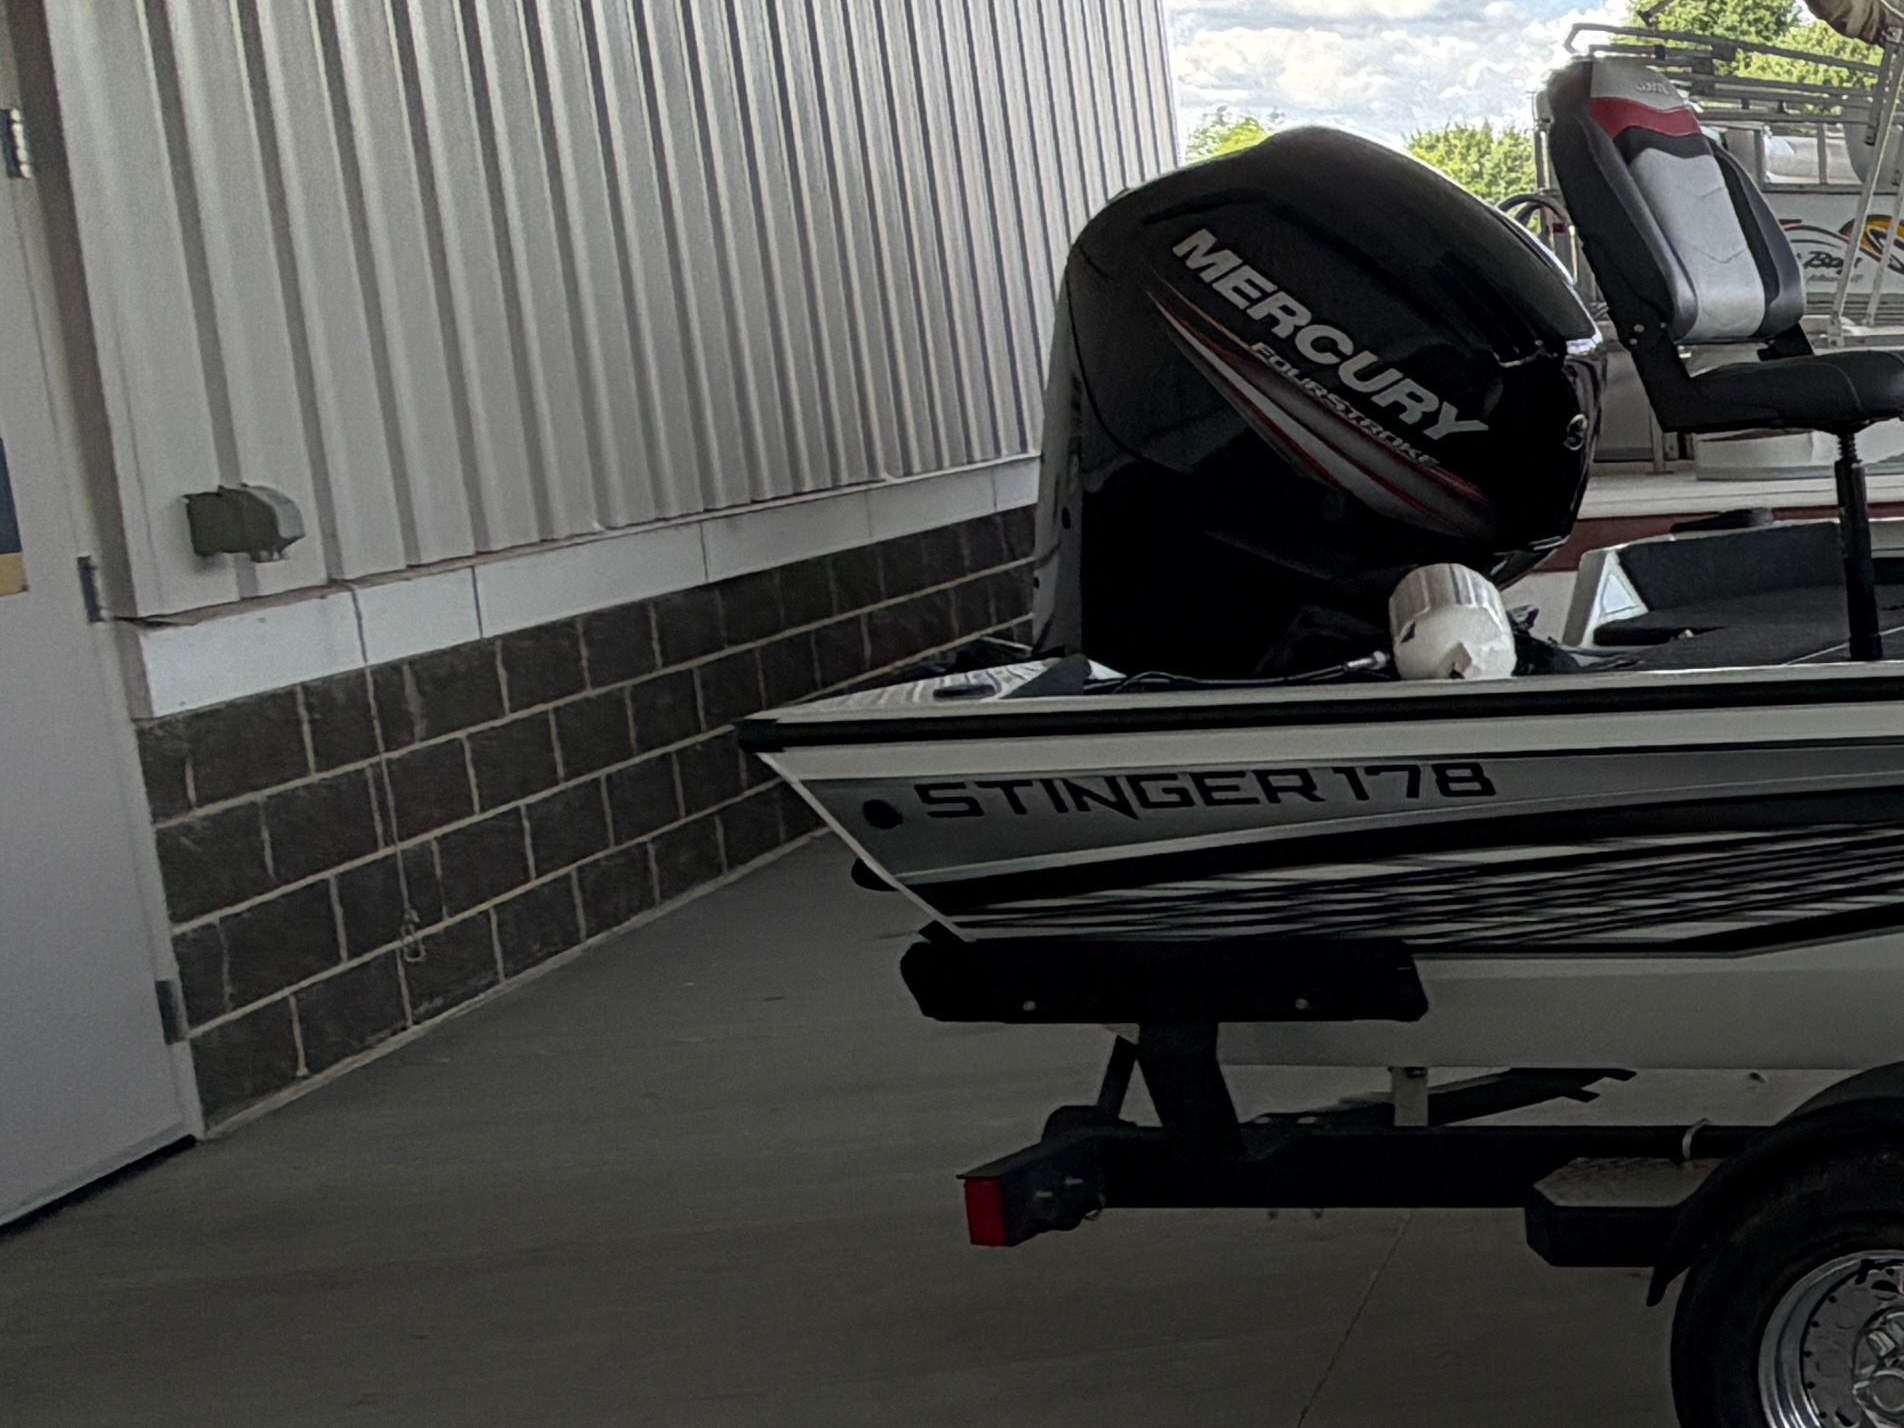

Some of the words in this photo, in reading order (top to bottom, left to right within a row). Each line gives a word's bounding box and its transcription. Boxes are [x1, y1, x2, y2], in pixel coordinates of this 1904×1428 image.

[1171, 227, 1490, 440] MERCURY
[914, 768, 1327, 820] STINGER
[1331, 761, 1497, 801] 178
